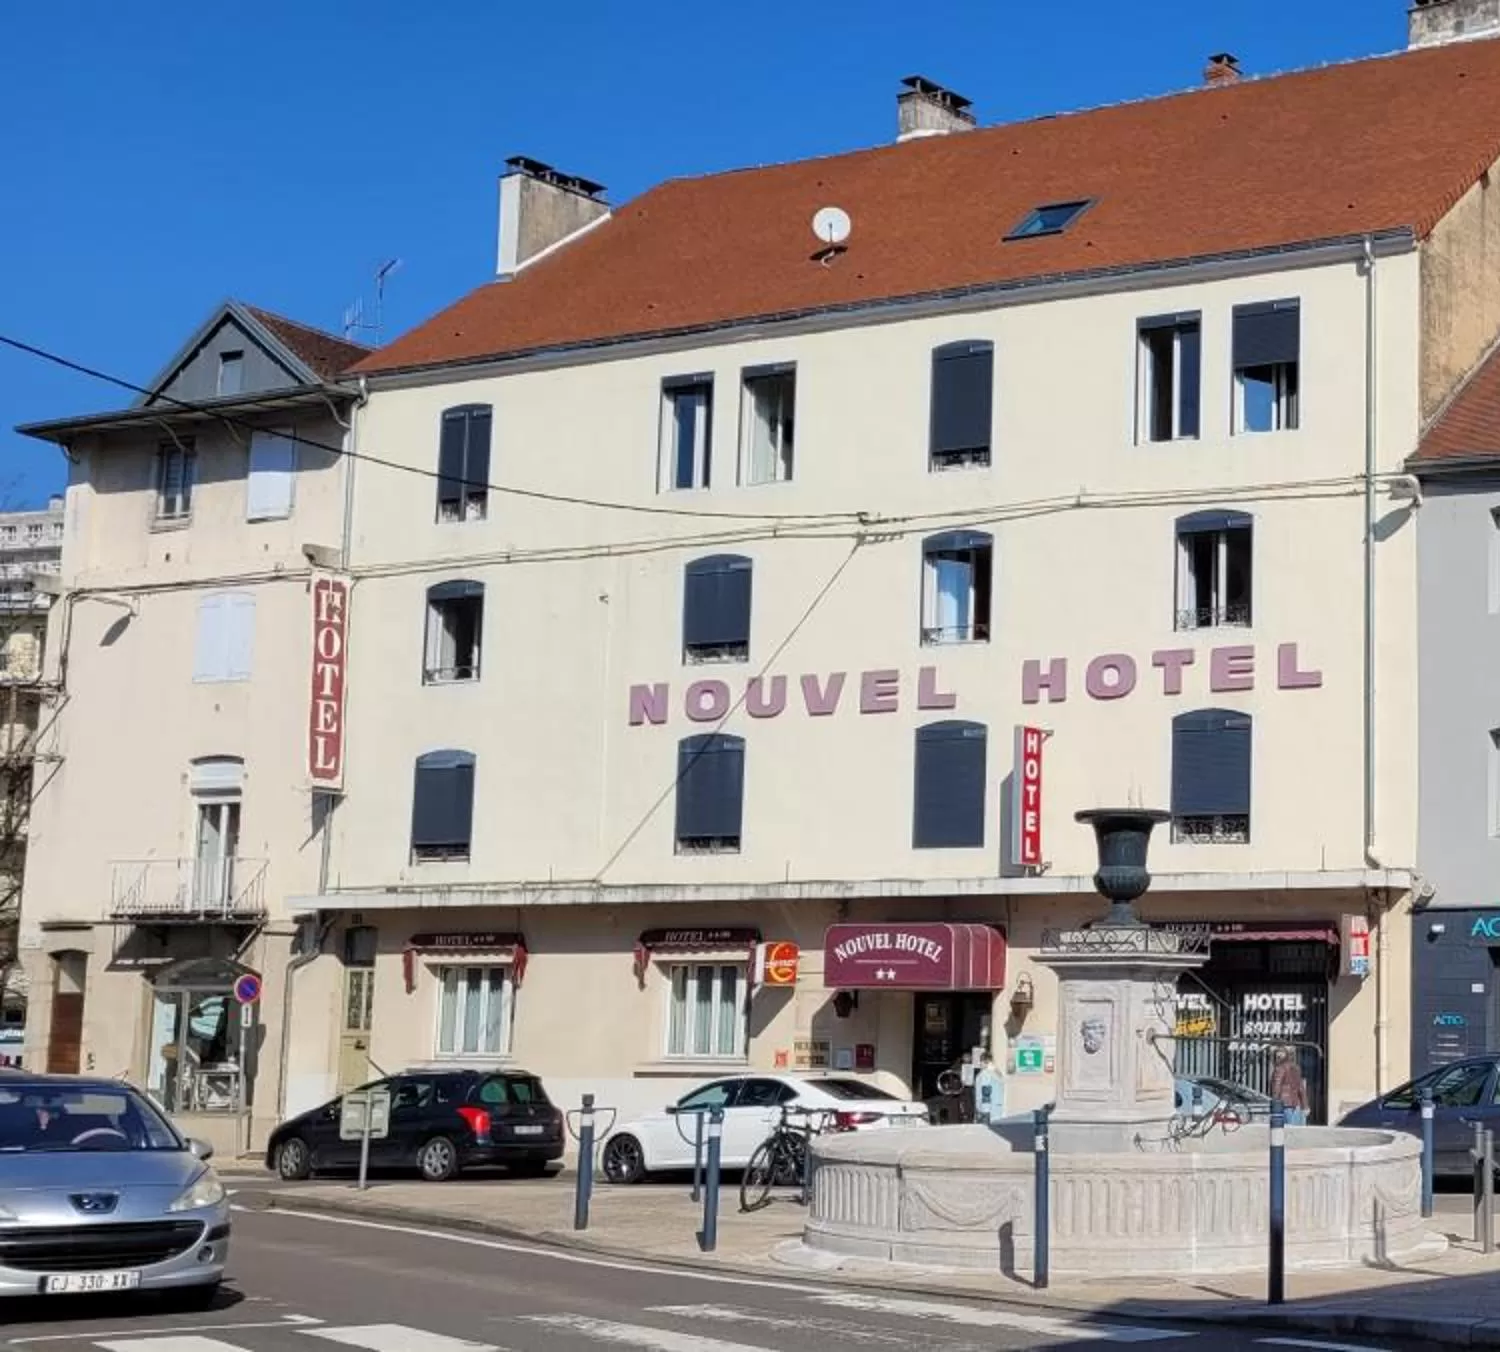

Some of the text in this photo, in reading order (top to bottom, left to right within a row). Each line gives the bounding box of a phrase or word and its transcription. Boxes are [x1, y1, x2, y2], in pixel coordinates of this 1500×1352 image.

[315, 588, 342, 770] HOTEL
[629, 642, 1323, 726] NOUVEL HOTEL
[1024, 732, 1039, 859] HOTEL
[833, 933, 944, 964] NOUVEL HOTEL
[1175, 993, 1307, 1011] VEL HOTEL
